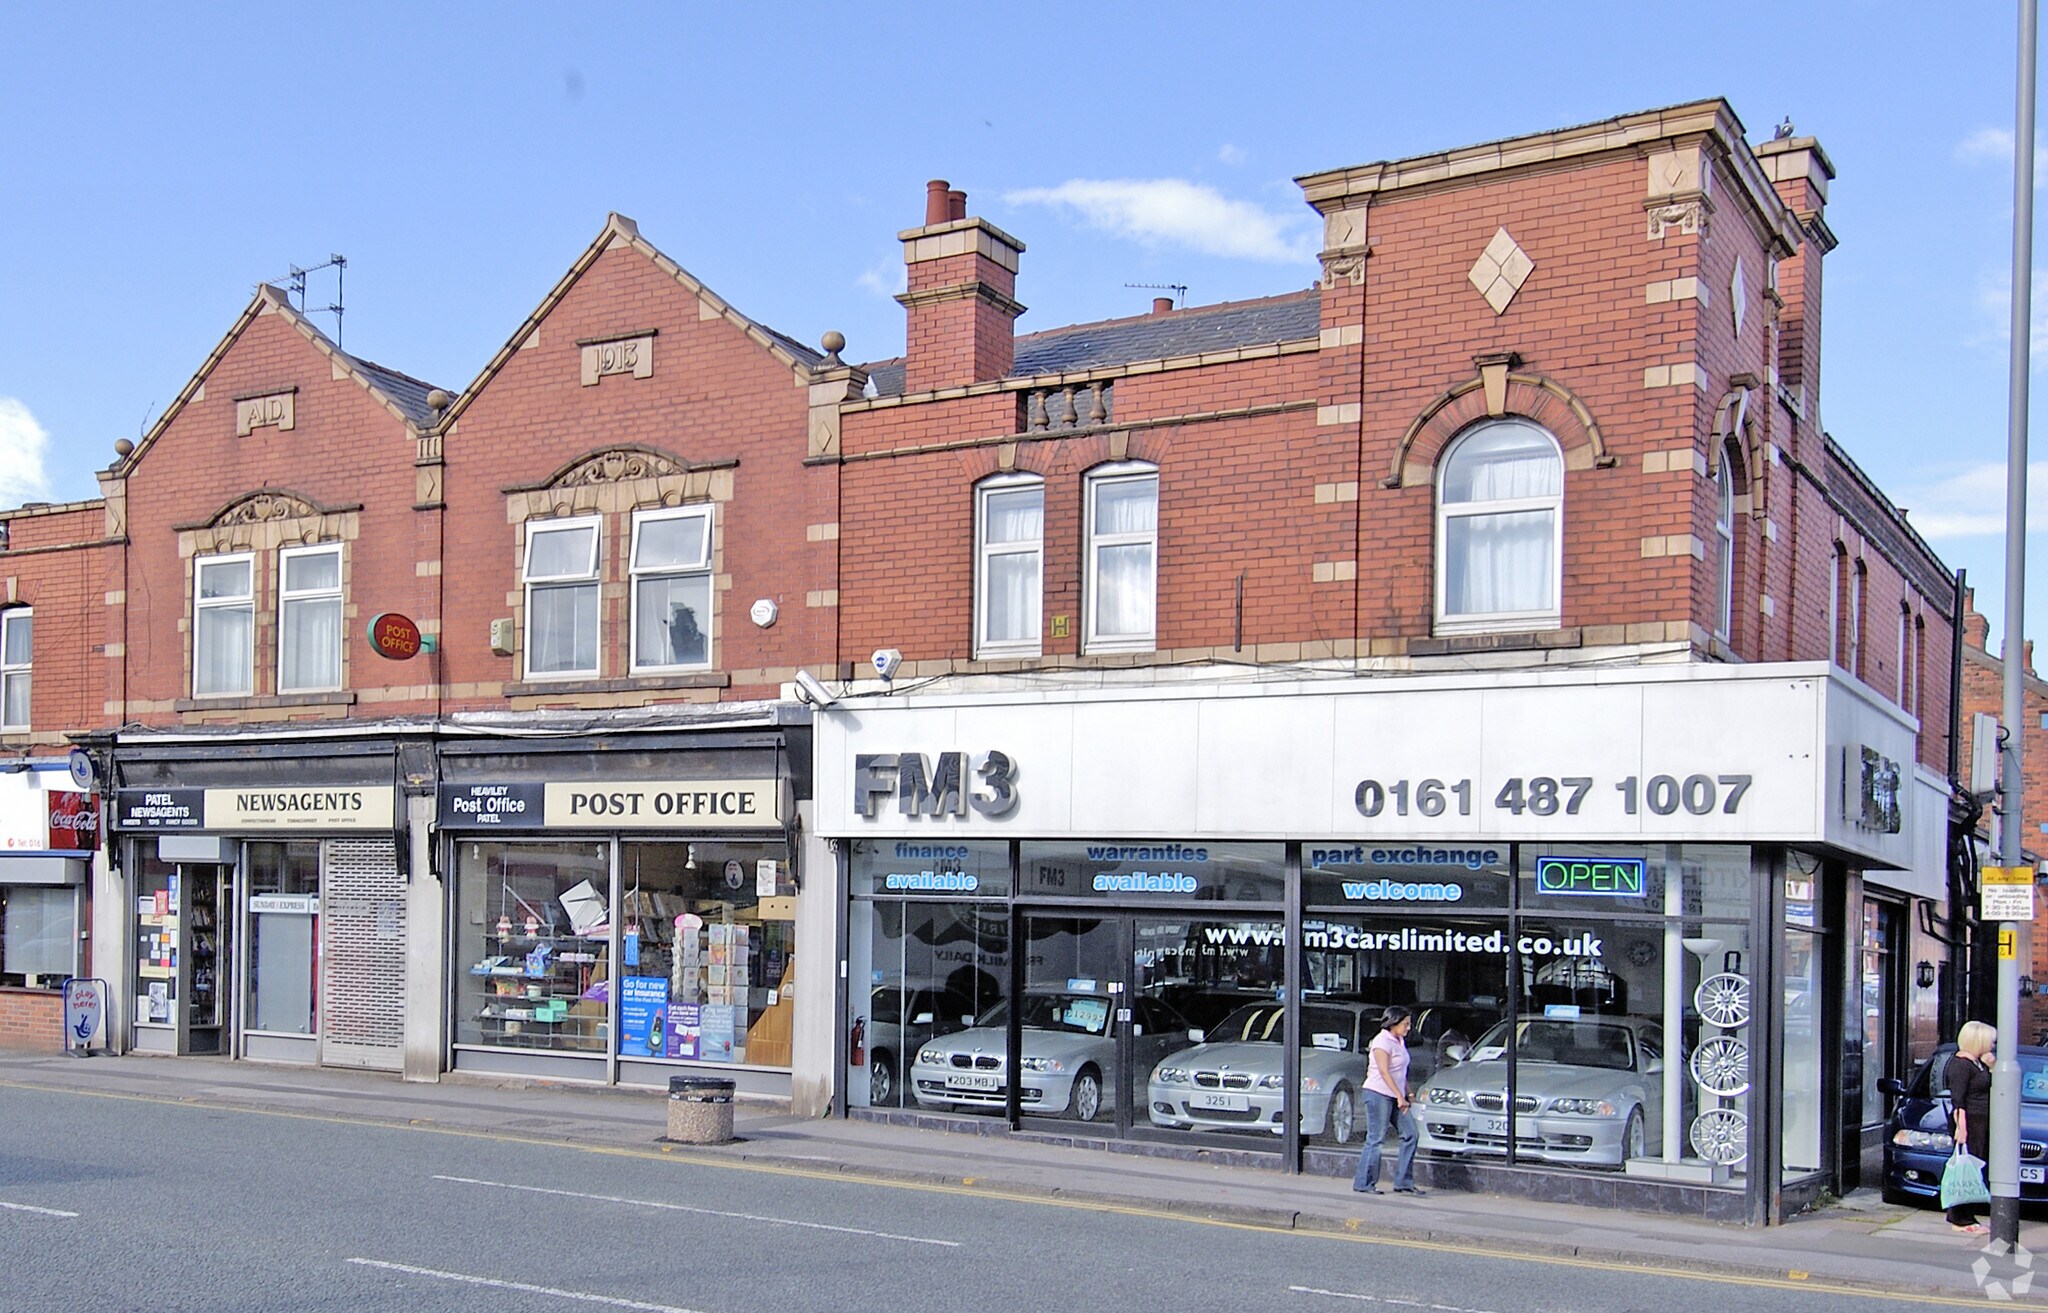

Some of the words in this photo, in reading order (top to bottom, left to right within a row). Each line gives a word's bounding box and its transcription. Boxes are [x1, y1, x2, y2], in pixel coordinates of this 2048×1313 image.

[594, 343, 638, 371] 1913
[386, 624, 411, 640] POST
[381, 636, 415, 653] OFFICE
[854, 750, 1019, 817] FM3
[145, 794, 174, 806] PATEL
[236, 792, 362, 812] NEWSAGENTS
[571, 793, 644, 815] POST
[654, 791, 756, 815] OFFICE
[1355, 779, 1471, 817] 0161
[1495, 777, 1593, 816] 487
[1615, 774, 1752, 816] 1007
[131, 806, 190, 818] NEWSAGENTS
[453, 797, 482, 813] Post
[486, 797, 526, 813] Office
[50, 810, 98, 831] Coca-Cola
[477, 813, 501, 823] PATEL
[895, 842, 968, 859] finance
[1087, 844, 1208, 862] warranties
[1312, 846, 1364, 869] part
[1371, 846, 1500, 870] exchange
[886, 871, 978, 890] available
[1039, 866, 1065, 886] FM3
[1093, 872, 1197, 893] available
[1542, 862, 1638, 892] OPEN
[1342, 879, 1462, 901] welcome
[253, 900, 275, 909] SUNDAY
[279, 900, 305, 909] EXPRESS
[623, 979, 635, 989] Go
[636, 980, 647, 989] for
[648, 982, 666, 991] new
[75, 990, 95, 1000] play
[948, 1076, 972, 1086] W203
[974, 1077, 995, 1087] MBJ
[1205, 1095, 1225, 1106] 325
